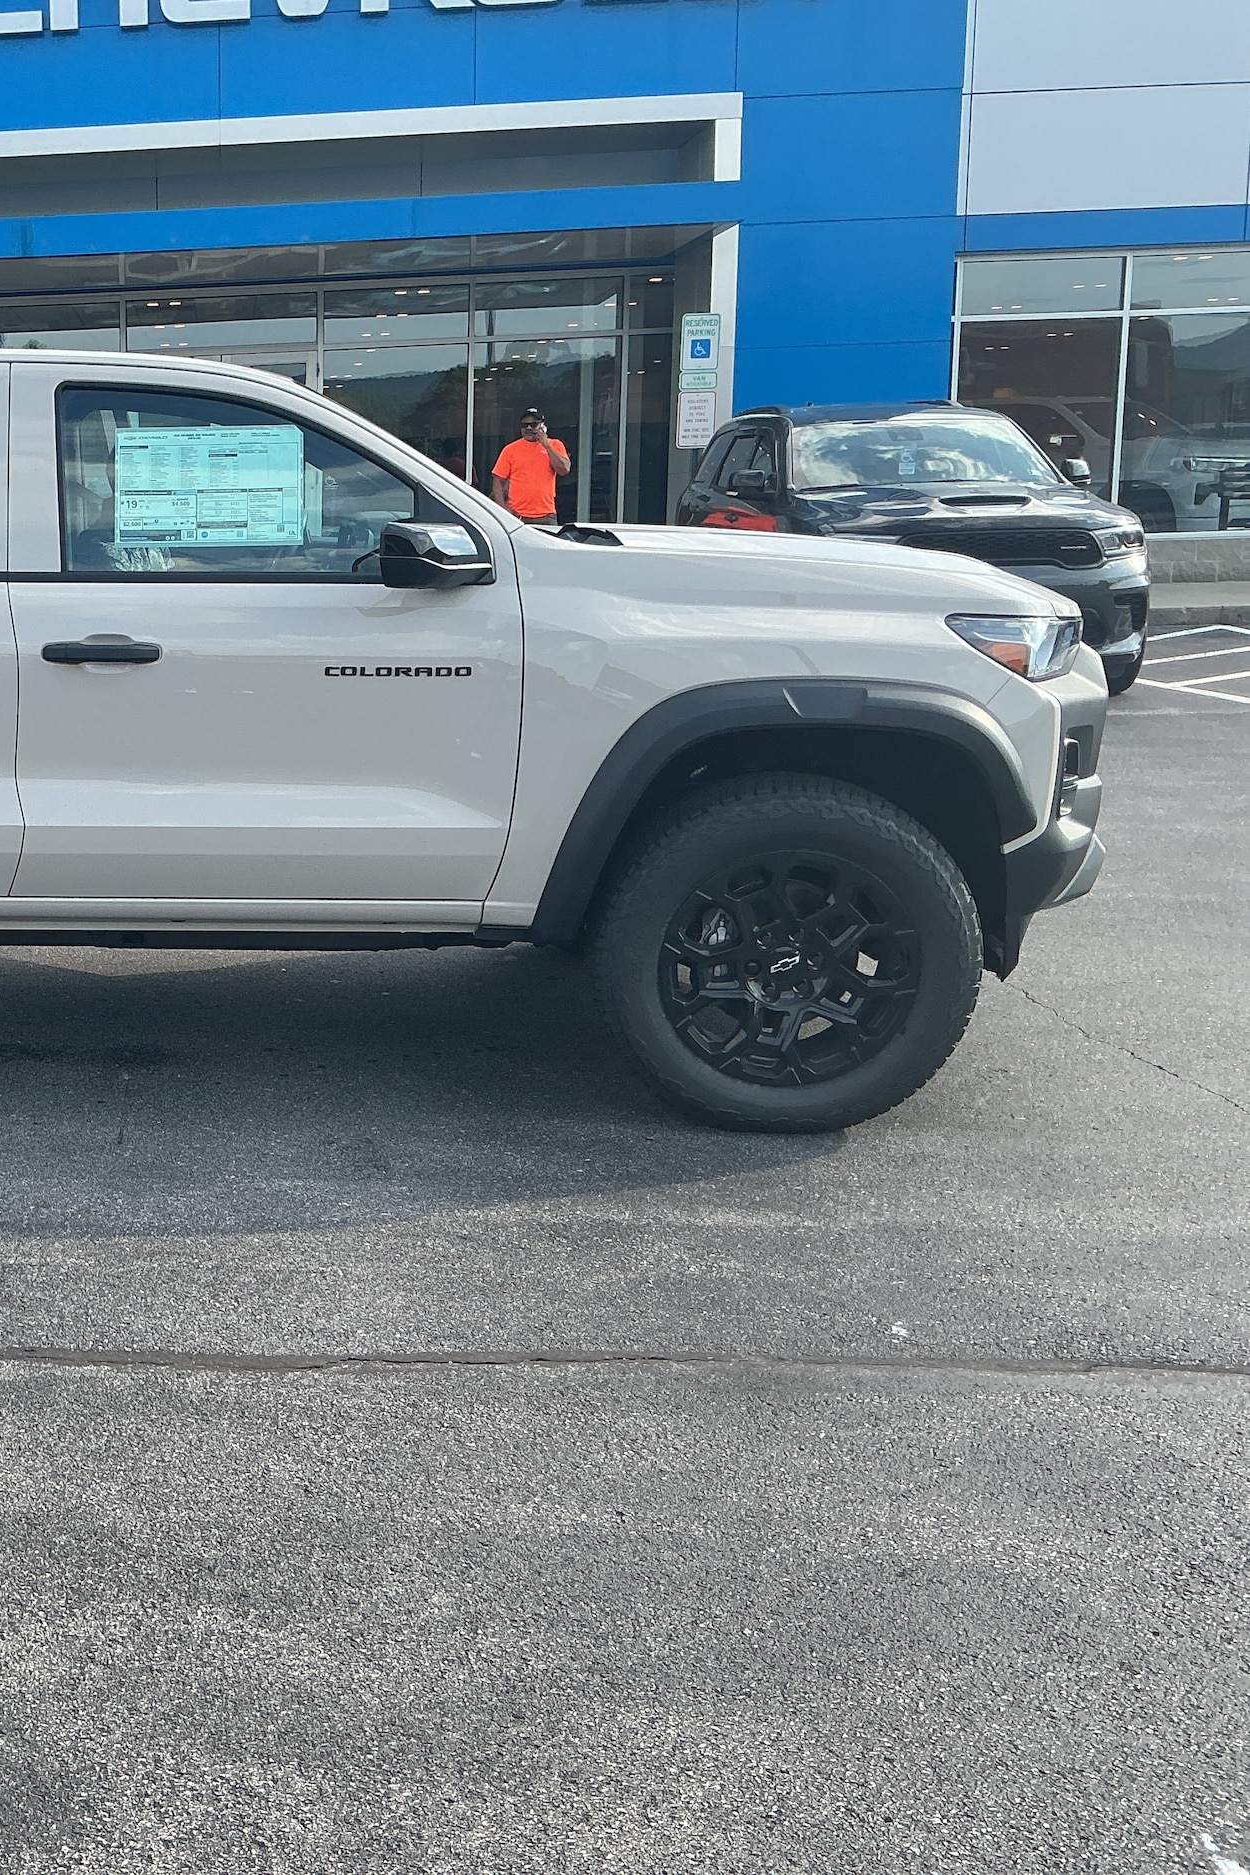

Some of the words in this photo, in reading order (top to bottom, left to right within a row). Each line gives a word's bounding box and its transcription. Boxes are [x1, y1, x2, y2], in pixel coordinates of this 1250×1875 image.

[685, 319, 719, 327] RESERVED
[687, 328, 716, 337] PARKING
[125, 500, 138, 509] 19
[324, 666, 472, 677] COLORADO
